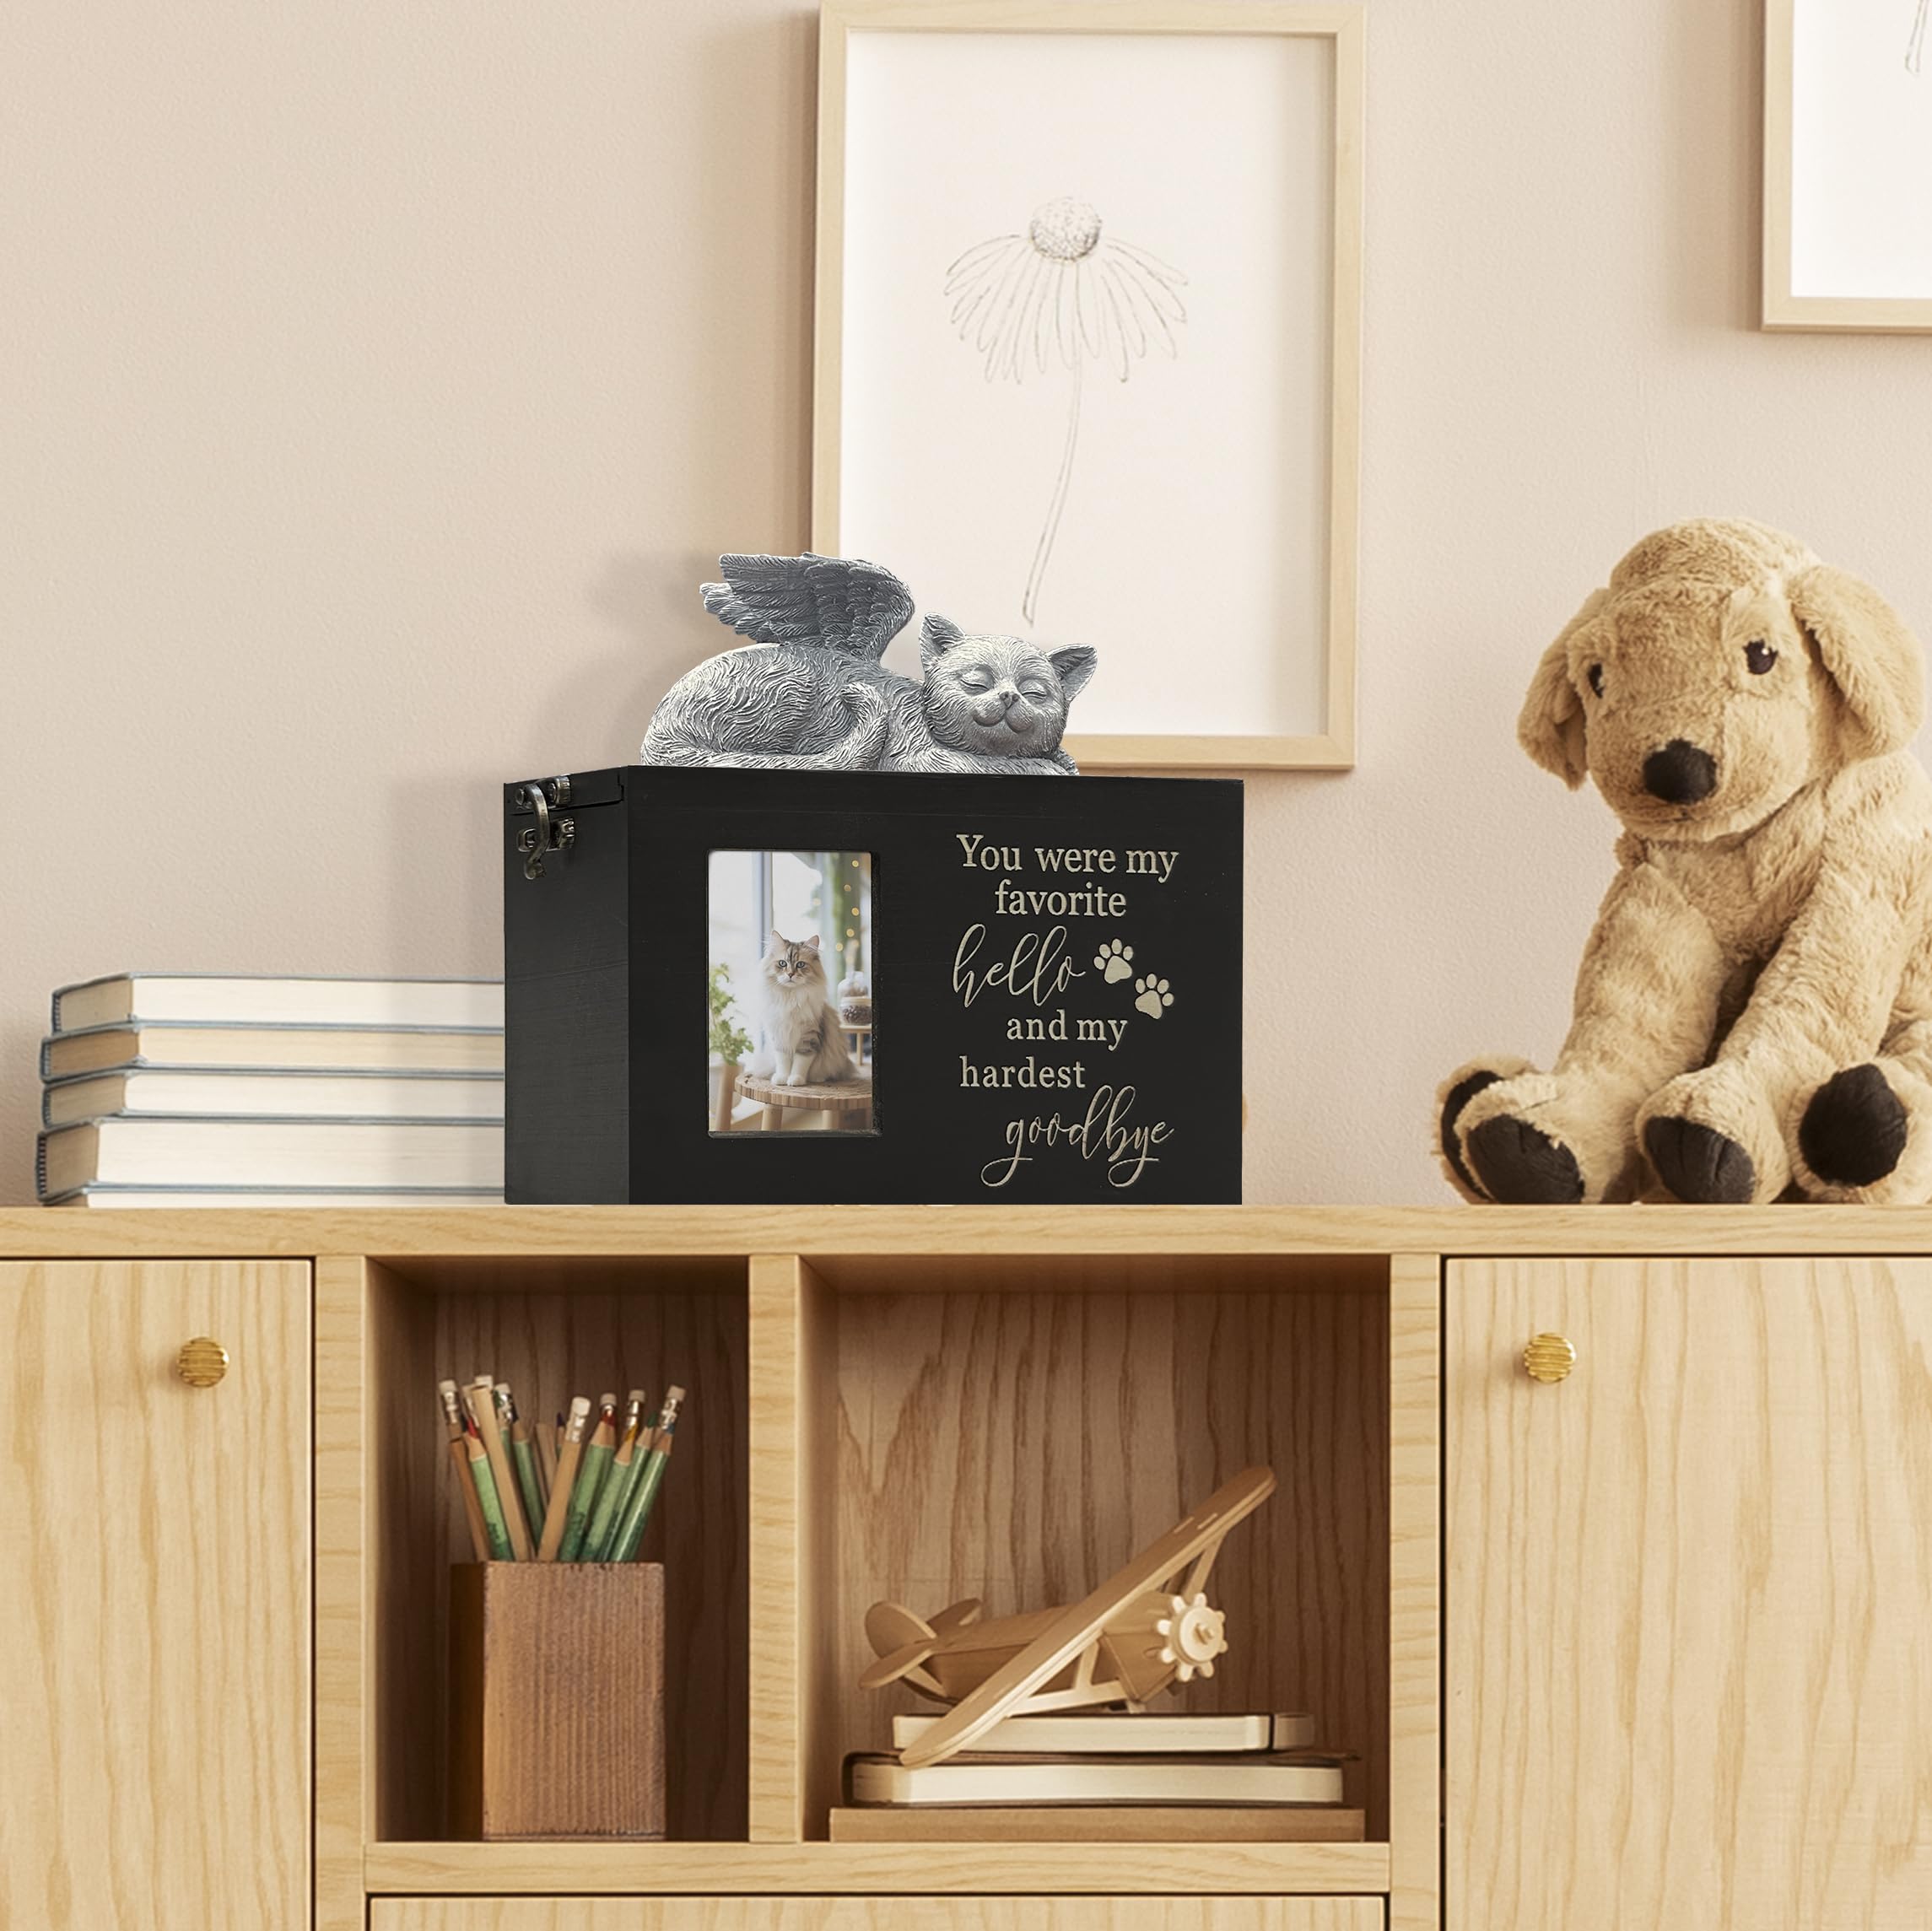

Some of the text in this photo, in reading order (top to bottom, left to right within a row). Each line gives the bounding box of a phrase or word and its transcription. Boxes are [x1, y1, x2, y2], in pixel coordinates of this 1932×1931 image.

[956, 833, 1179, 884] You were my
[994, 878, 1127, 917] favorite
[953, 923, 1087, 1008] hello
[1006, 1009, 1128, 1052] and my
[958, 1055, 1086, 1089] hardest
[979, 1084, 1175, 1188] goodbye
